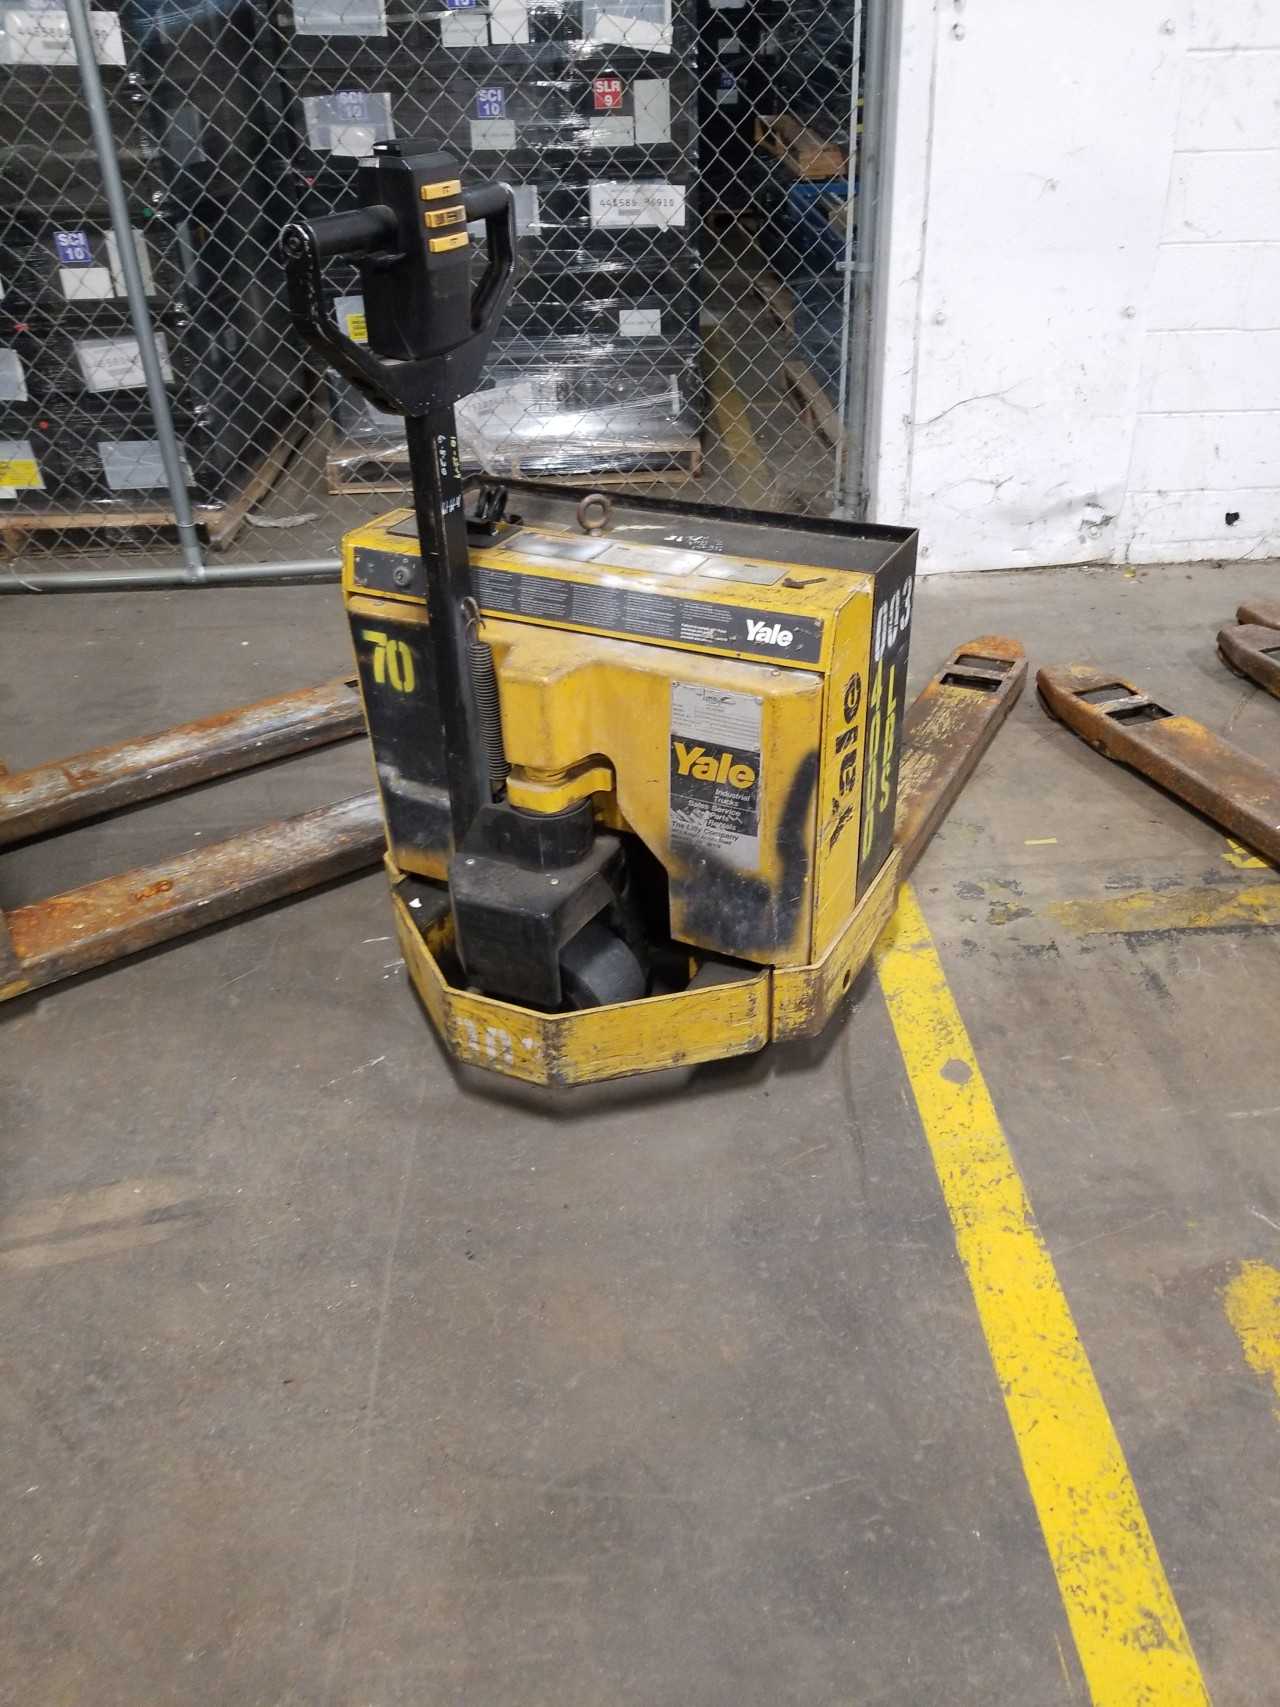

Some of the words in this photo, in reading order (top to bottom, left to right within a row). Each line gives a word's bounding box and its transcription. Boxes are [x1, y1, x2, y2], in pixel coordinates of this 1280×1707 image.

[594, 80, 620, 92] SLR
[479, 89, 501, 102] SCI
[604, 95, 614, 107] 9
[482, 103, 500, 116] 10
[57, 233, 86, 247] SCI
[65, 247, 85, 260] 10
[746, 619, 794, 647] Yale
[362, 629, 415, 693] 70
[879, 664, 897, 813] LBS
[673, 741, 756, 789] Yale
[833, 671, 862, 857] Yale
[861, 655, 884, 862] 4000
[715, 788, 751, 801] Industrial
[714, 796, 740, 807] Trucks
[711, 805, 742, 817] Service
